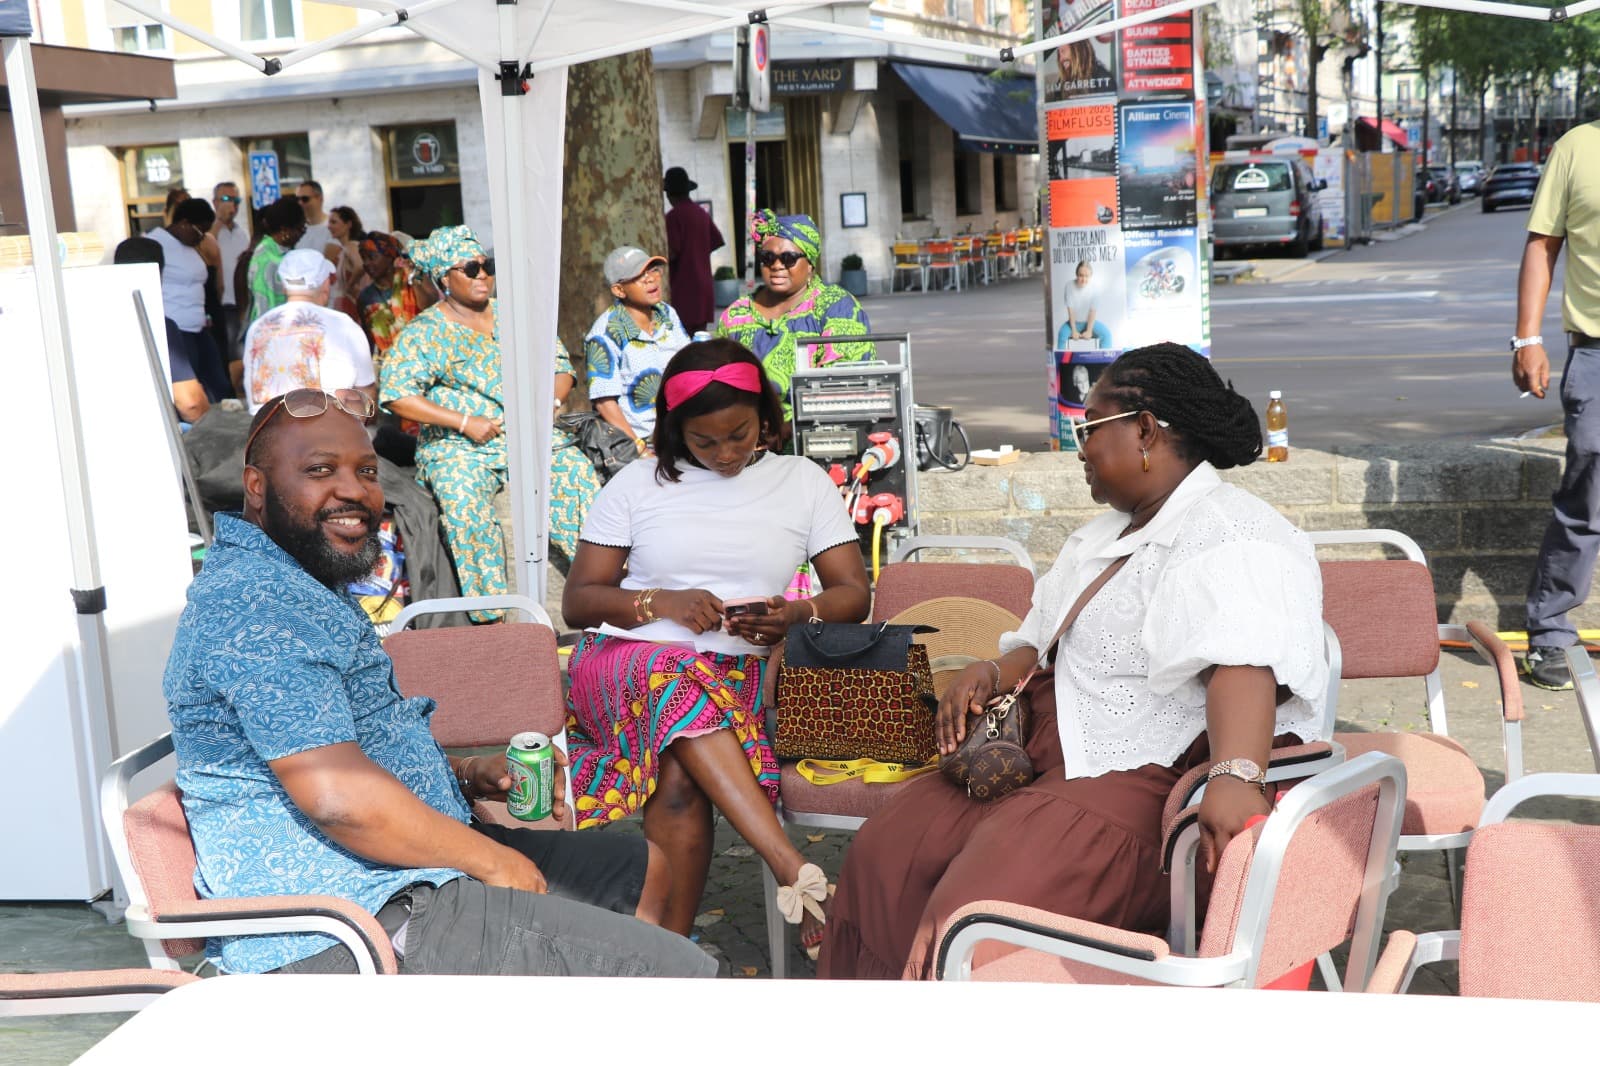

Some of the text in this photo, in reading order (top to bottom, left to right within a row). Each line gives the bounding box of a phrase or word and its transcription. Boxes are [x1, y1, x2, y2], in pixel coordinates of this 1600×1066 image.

[772, 68, 841, 83] THE YARD
[777, 82, 835, 91] RESTAURANT
[1064, 77, 1111, 91] GARRETT
[1048, 115, 1111, 130] FILMFLUSS
[1128, 110, 1190, 122] Allianz Cinema
[1053, 245, 1118, 264] DO YOU MISS ME?
